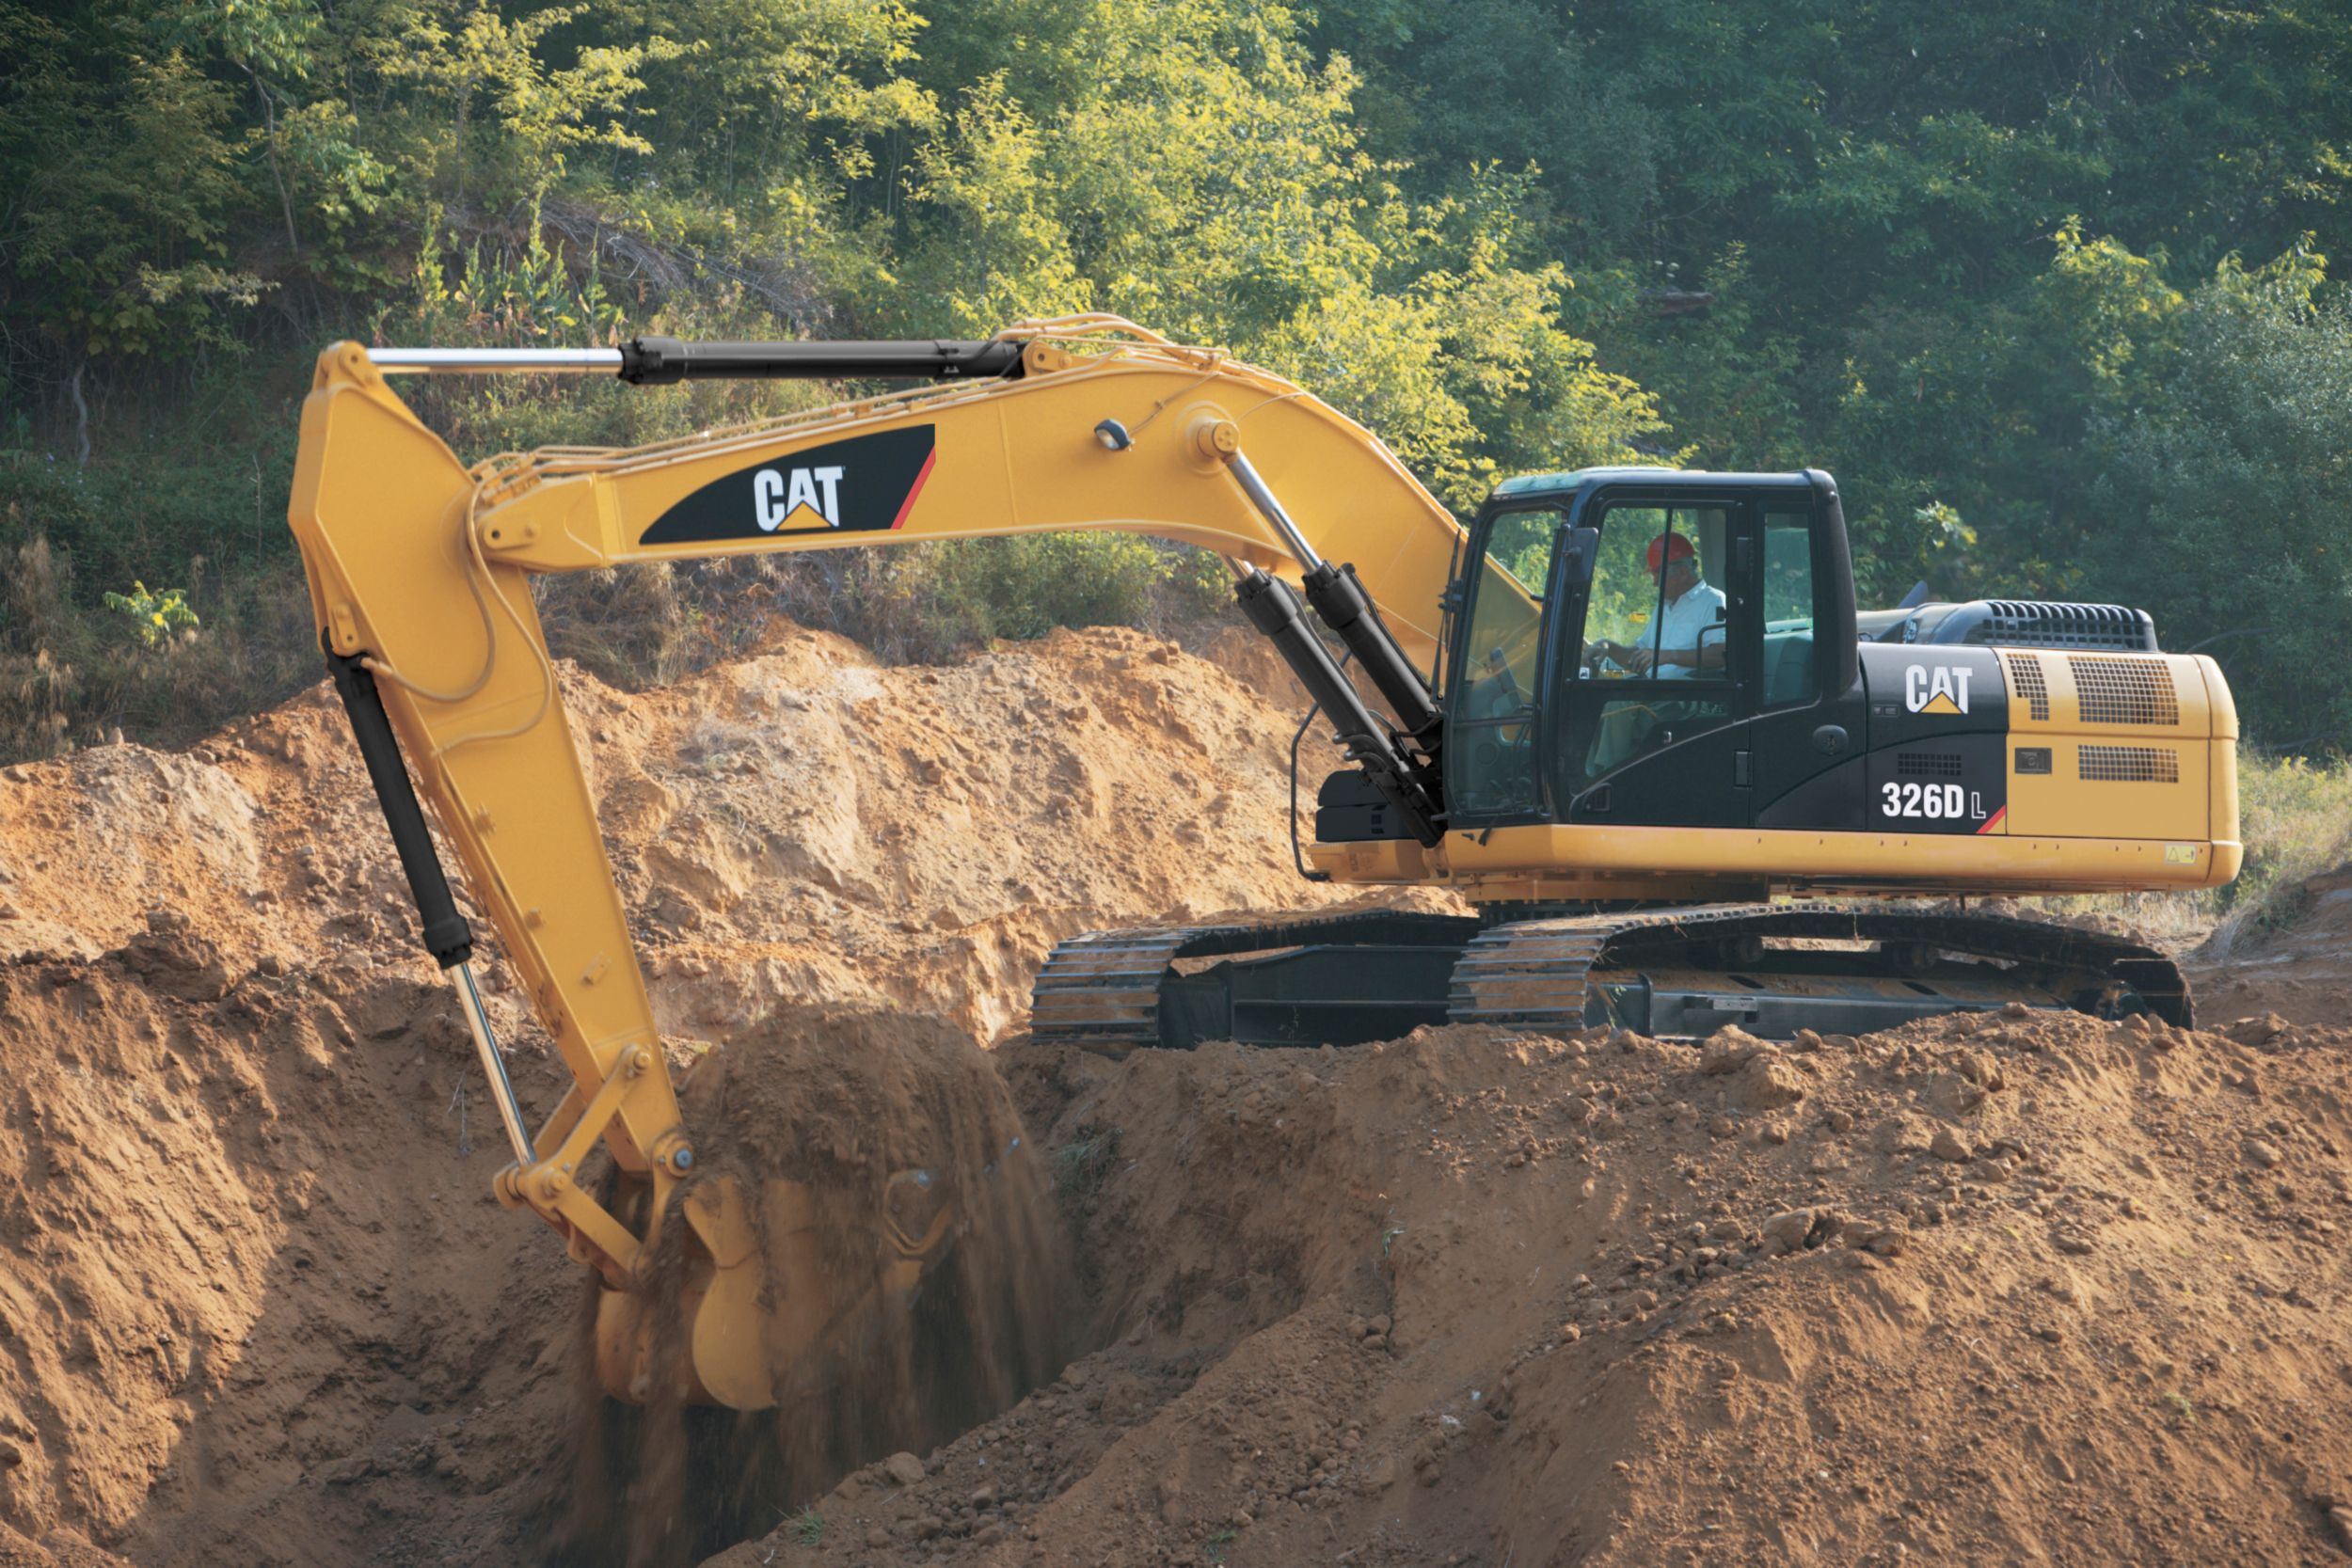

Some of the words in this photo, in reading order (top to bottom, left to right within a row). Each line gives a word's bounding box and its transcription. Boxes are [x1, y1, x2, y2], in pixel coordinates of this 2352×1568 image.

[754, 466, 843, 531] CAT
[1905, 664, 1973, 714] CAT
[1882, 782, 1964, 818] 326D
[1971, 791, 1986, 819] L
